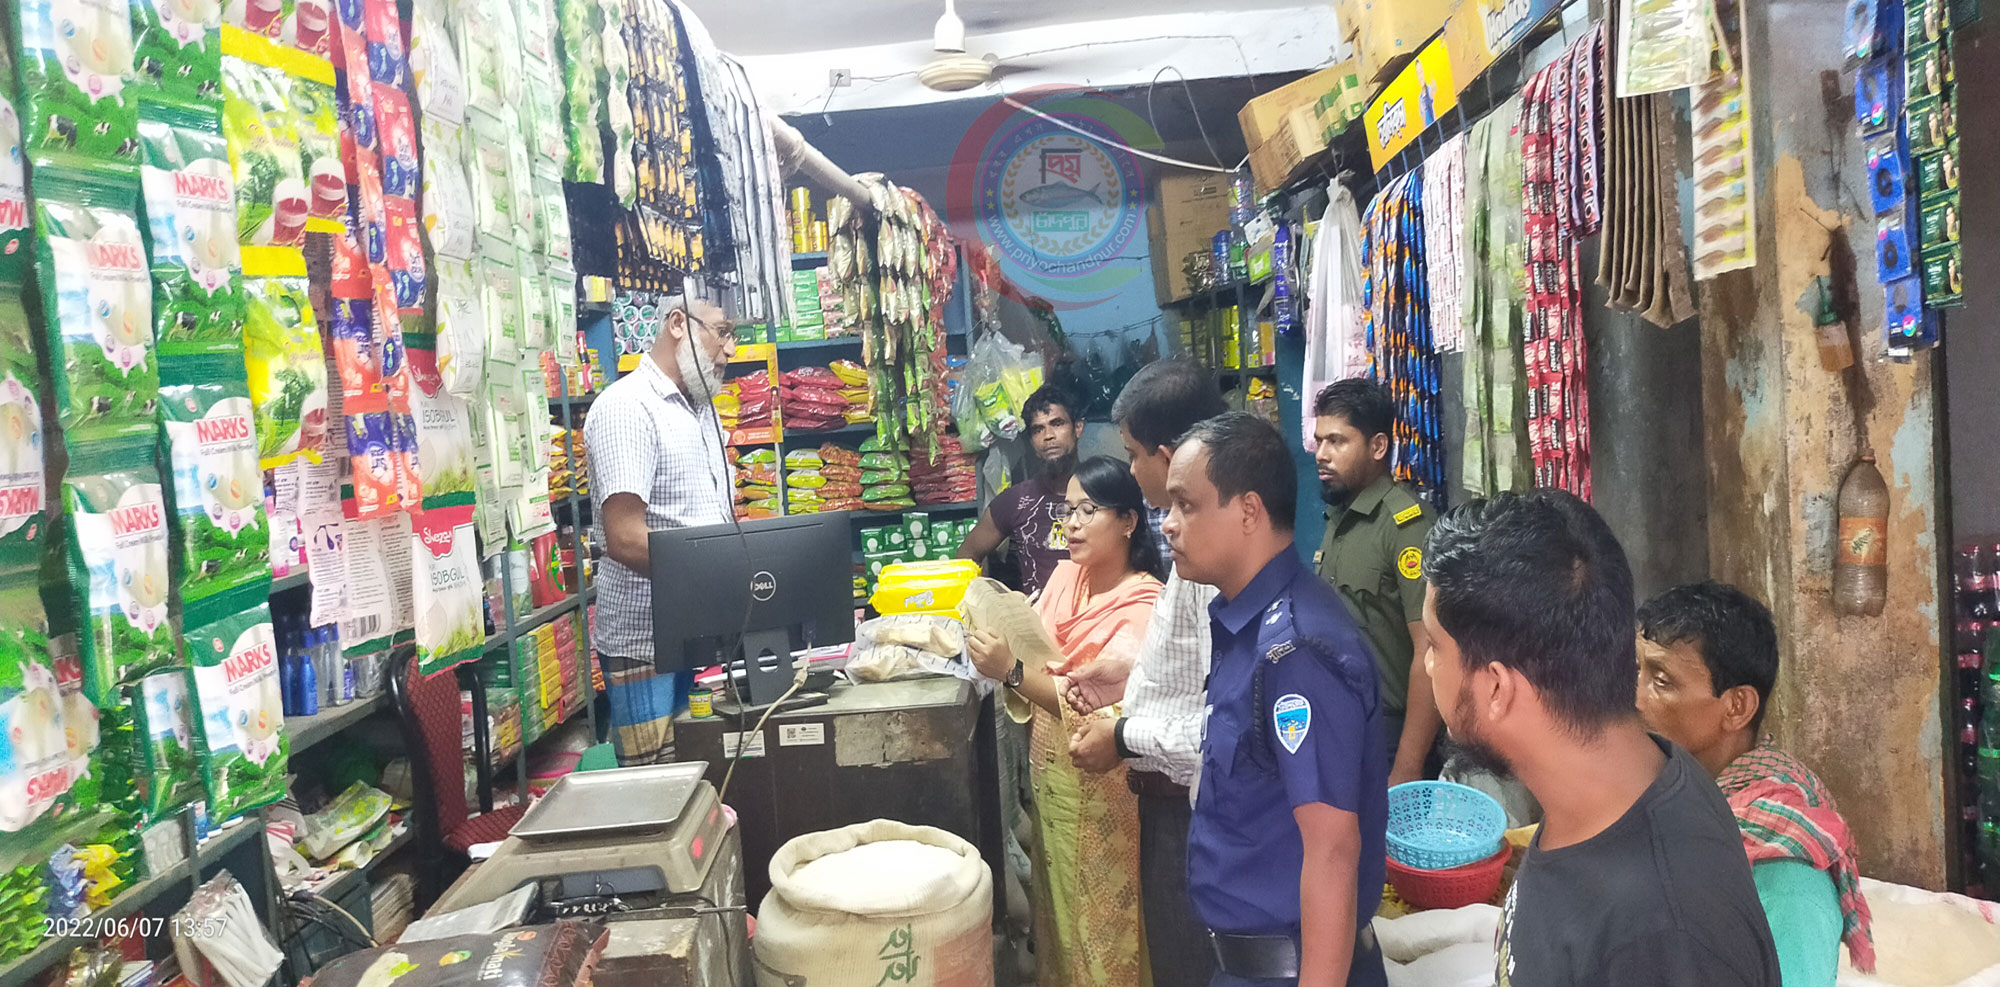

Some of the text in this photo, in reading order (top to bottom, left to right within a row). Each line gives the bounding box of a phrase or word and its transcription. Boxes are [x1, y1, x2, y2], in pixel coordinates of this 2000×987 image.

[175, 172, 228, 201] MARKS
[196, 417, 249, 443] MARKS
[108, 504, 159, 535] MARKS
[752, 581, 774, 592] DELL
[224, 644, 272, 682] MARKS
